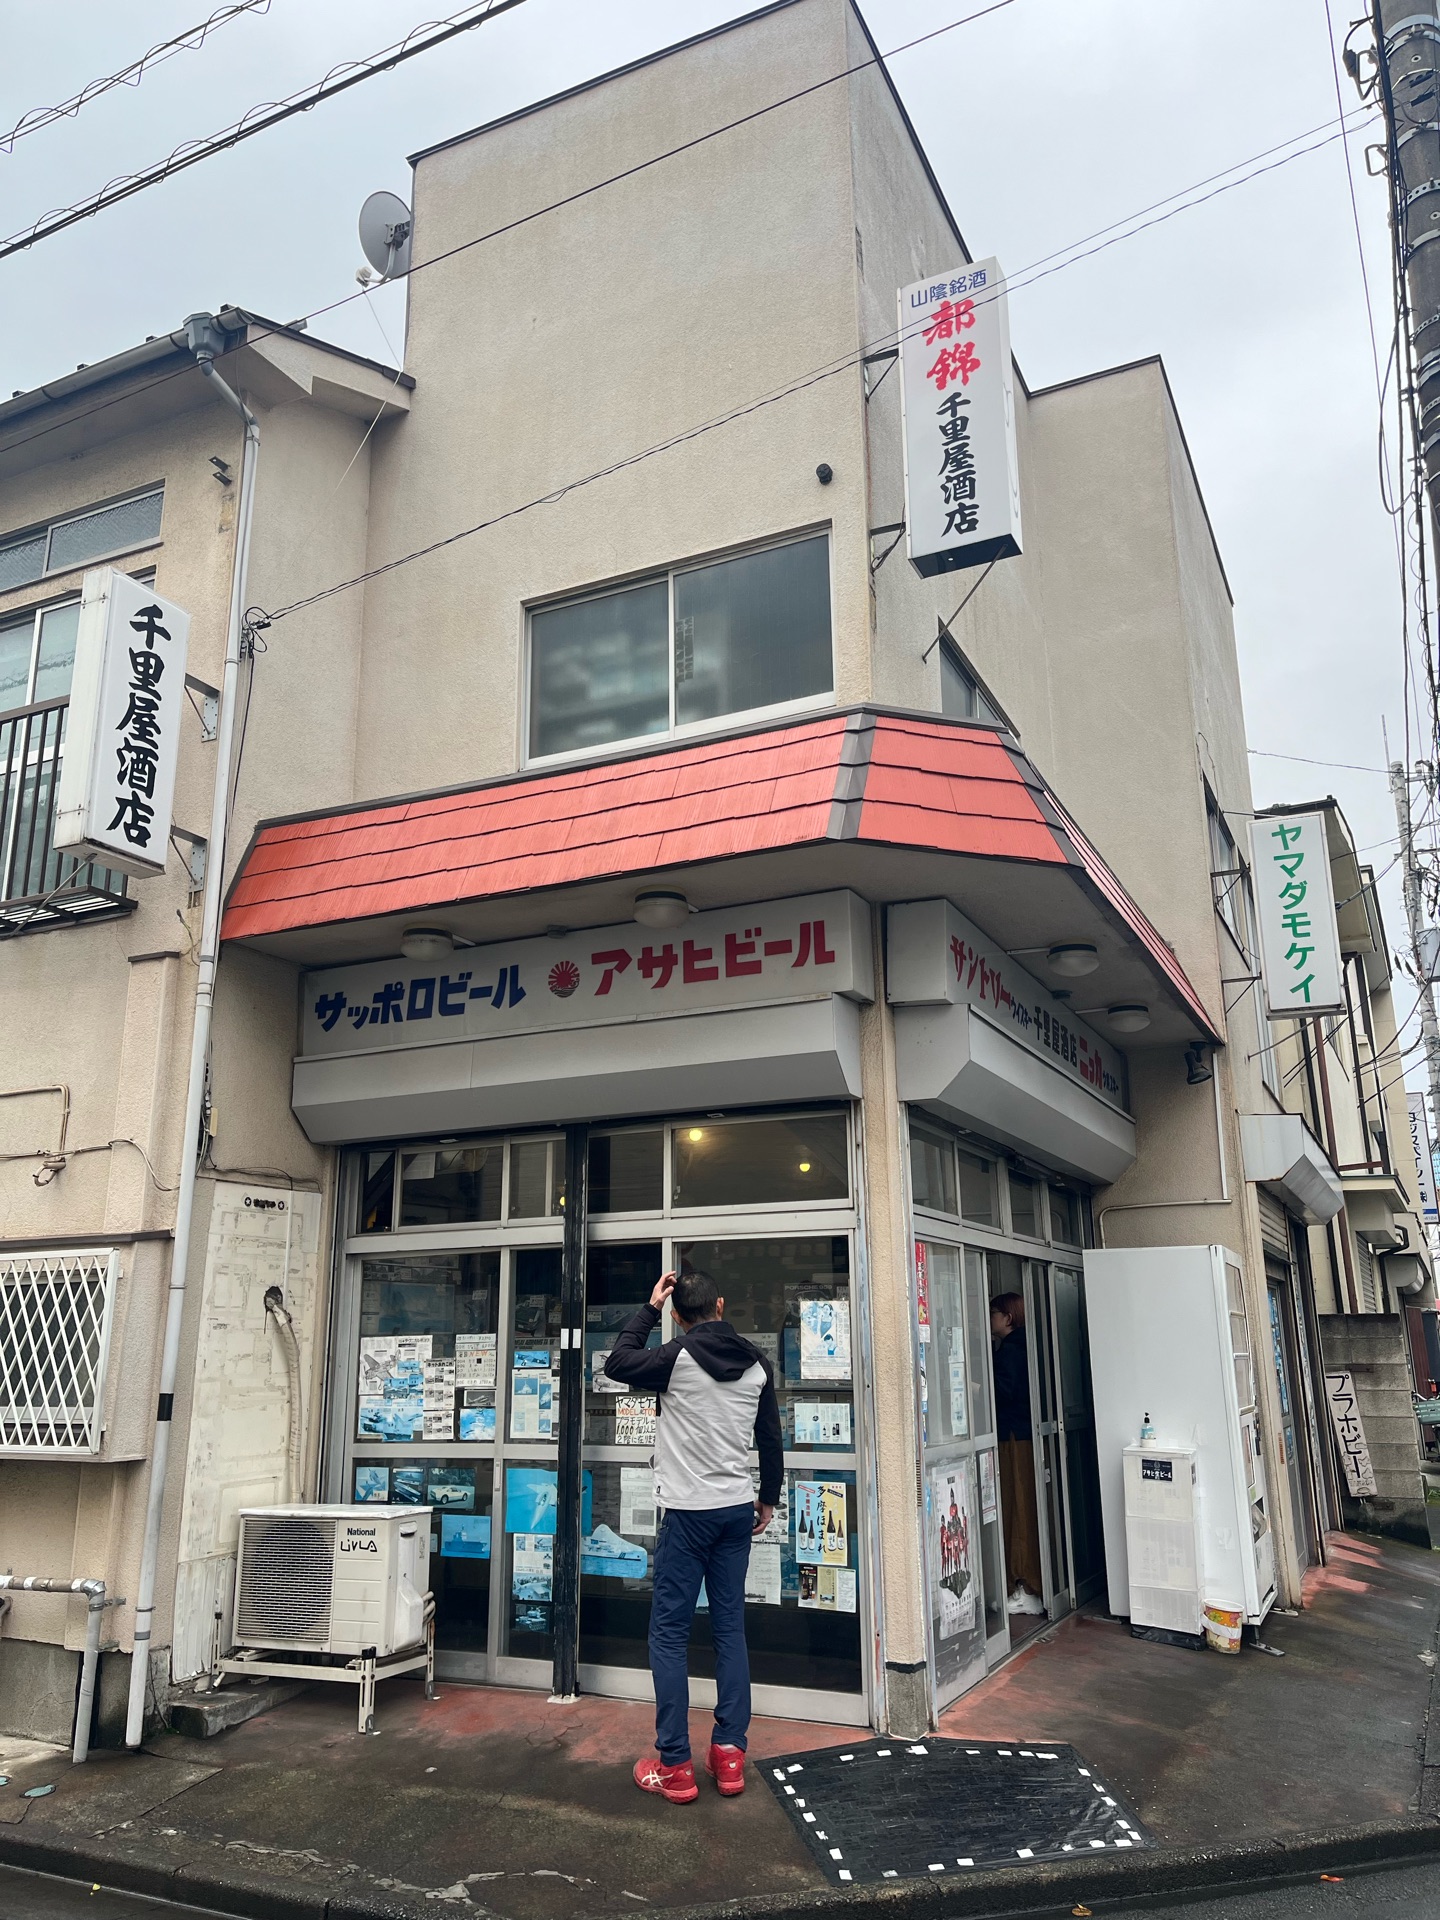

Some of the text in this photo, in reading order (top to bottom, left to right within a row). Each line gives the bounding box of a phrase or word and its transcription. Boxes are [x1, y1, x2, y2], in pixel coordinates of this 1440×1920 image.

[910, 268, 987, 308] 山陰銘酒
[921, 298, 982, 391] 都錦
[936, 391, 980, 538] 千里屋酒店
[106, 603, 172, 849] 千里屋酒店
[1271, 823, 1316, 1003] ヤマダモケイ
[314, 919, 836, 1032] サッポロビール アサヒビール
[1033, 1005, 1078, 1068] 千里屋酒店
[617, 1408, 639, 1416] MODEL
[1325, 1373, 1363, 1479] プラホビー
[346, 1527, 377, 1537] National
